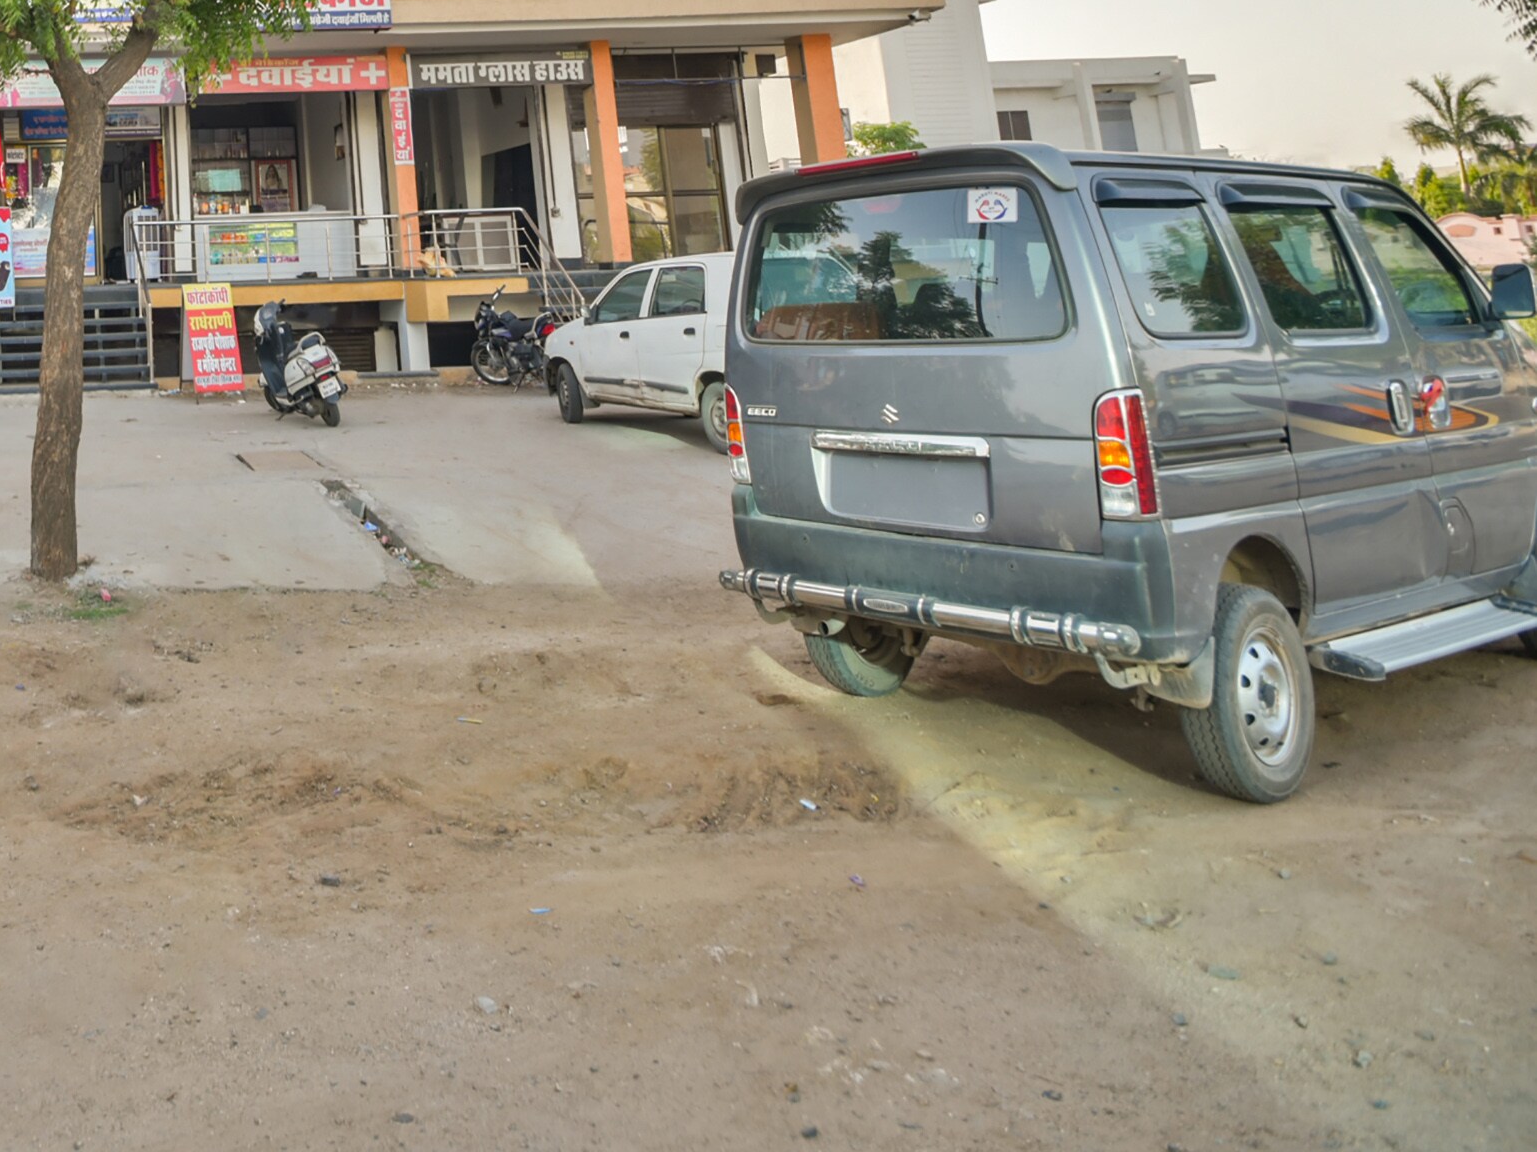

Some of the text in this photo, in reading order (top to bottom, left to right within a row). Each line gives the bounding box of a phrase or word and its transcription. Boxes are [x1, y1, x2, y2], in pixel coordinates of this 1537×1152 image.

[419, 60, 585, 84] ममता ग्लास हाउस
[747, 406, 777, 417] EECO
